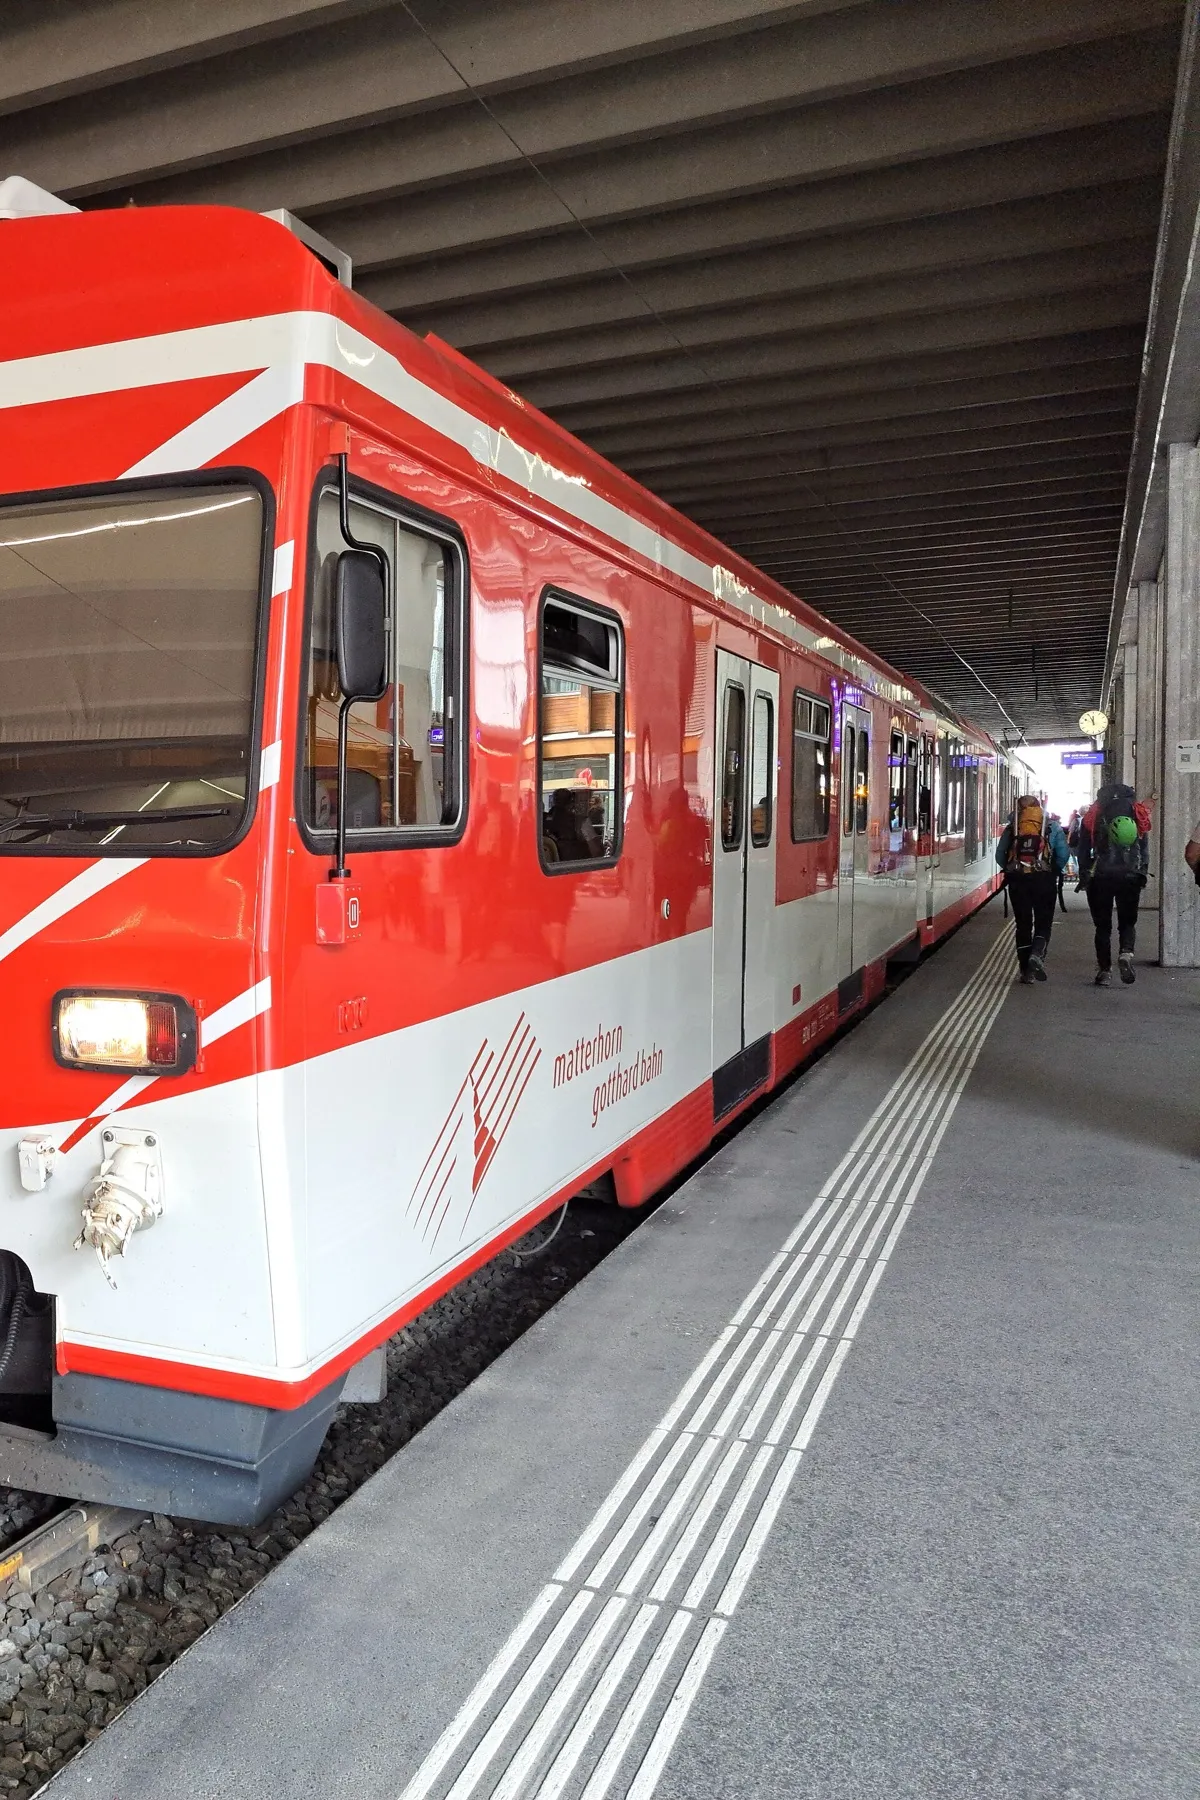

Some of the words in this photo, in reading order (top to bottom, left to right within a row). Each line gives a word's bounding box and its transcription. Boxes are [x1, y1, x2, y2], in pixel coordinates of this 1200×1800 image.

[553, 1023, 623, 1089] matterhorn
[591, 1050, 640, 1129] gotthard
[640, 1042, 663, 1087] bahn
